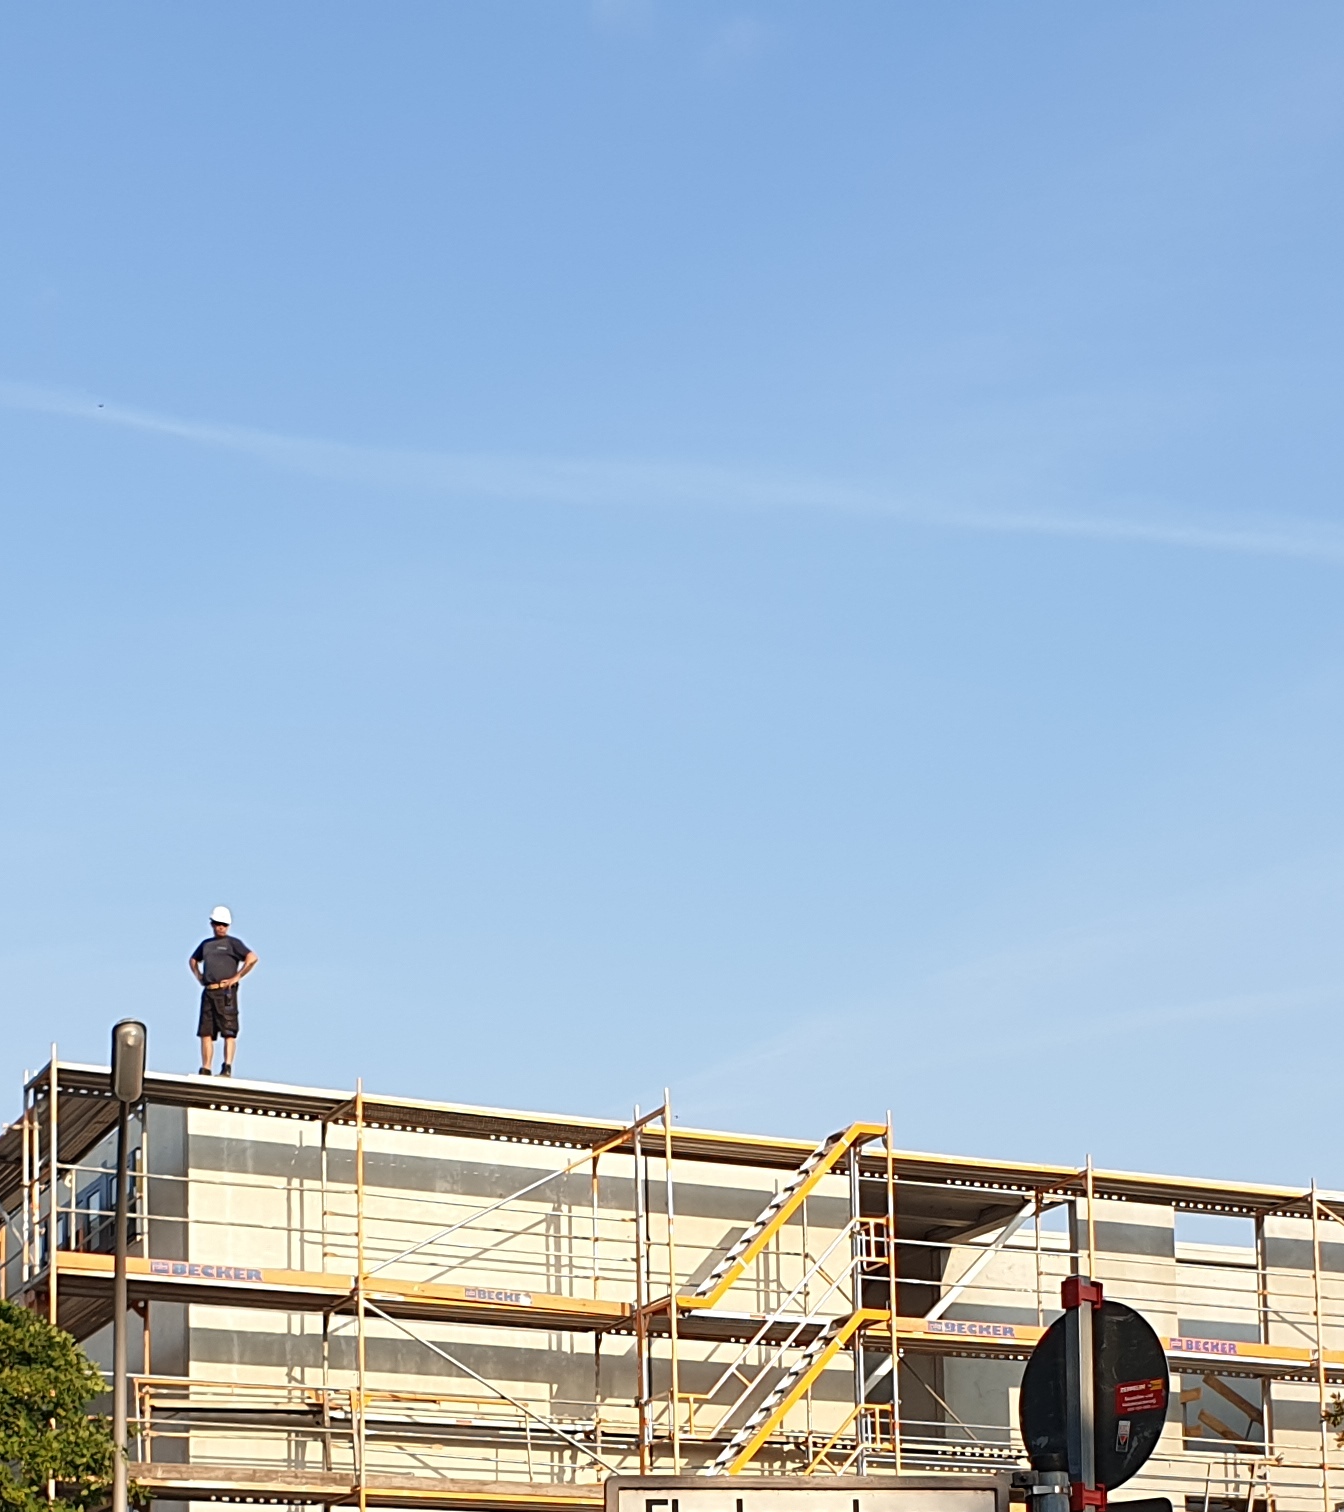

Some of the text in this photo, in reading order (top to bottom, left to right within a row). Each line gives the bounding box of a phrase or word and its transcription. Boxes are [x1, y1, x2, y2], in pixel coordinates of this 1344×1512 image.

[172, 1263, 263, 1282] BECKER
[944, 1322, 1015, 1337] BECKER
[1186, 1340, 1237, 1354] BECKER
